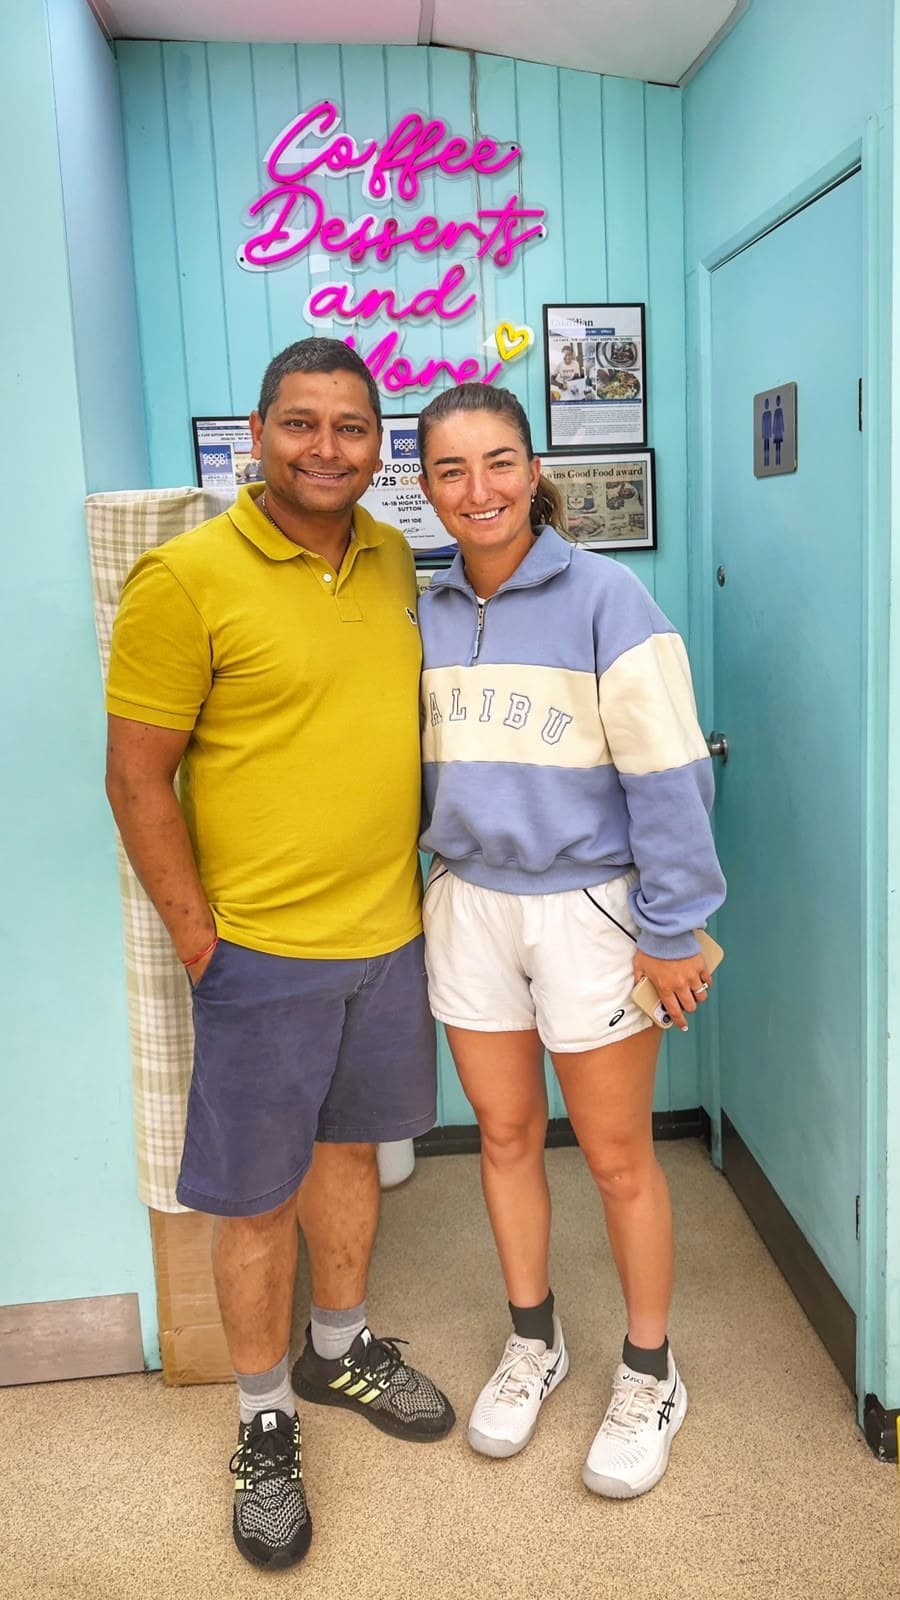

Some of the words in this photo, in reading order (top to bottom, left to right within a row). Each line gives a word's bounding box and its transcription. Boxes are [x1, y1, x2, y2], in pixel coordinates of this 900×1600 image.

[266, 101, 522, 200] Coffee
[244, 184, 545, 267] Desserts
[309, 264, 477, 320] and
[371, 476, 397, 488] /25
[384, 464, 421, 474] FOOD
[567, 469, 591, 479] Good
[593, 468, 614, 477] Food
[615, 467, 643, 476] award
[429, 687, 573, 746] ALIBU
